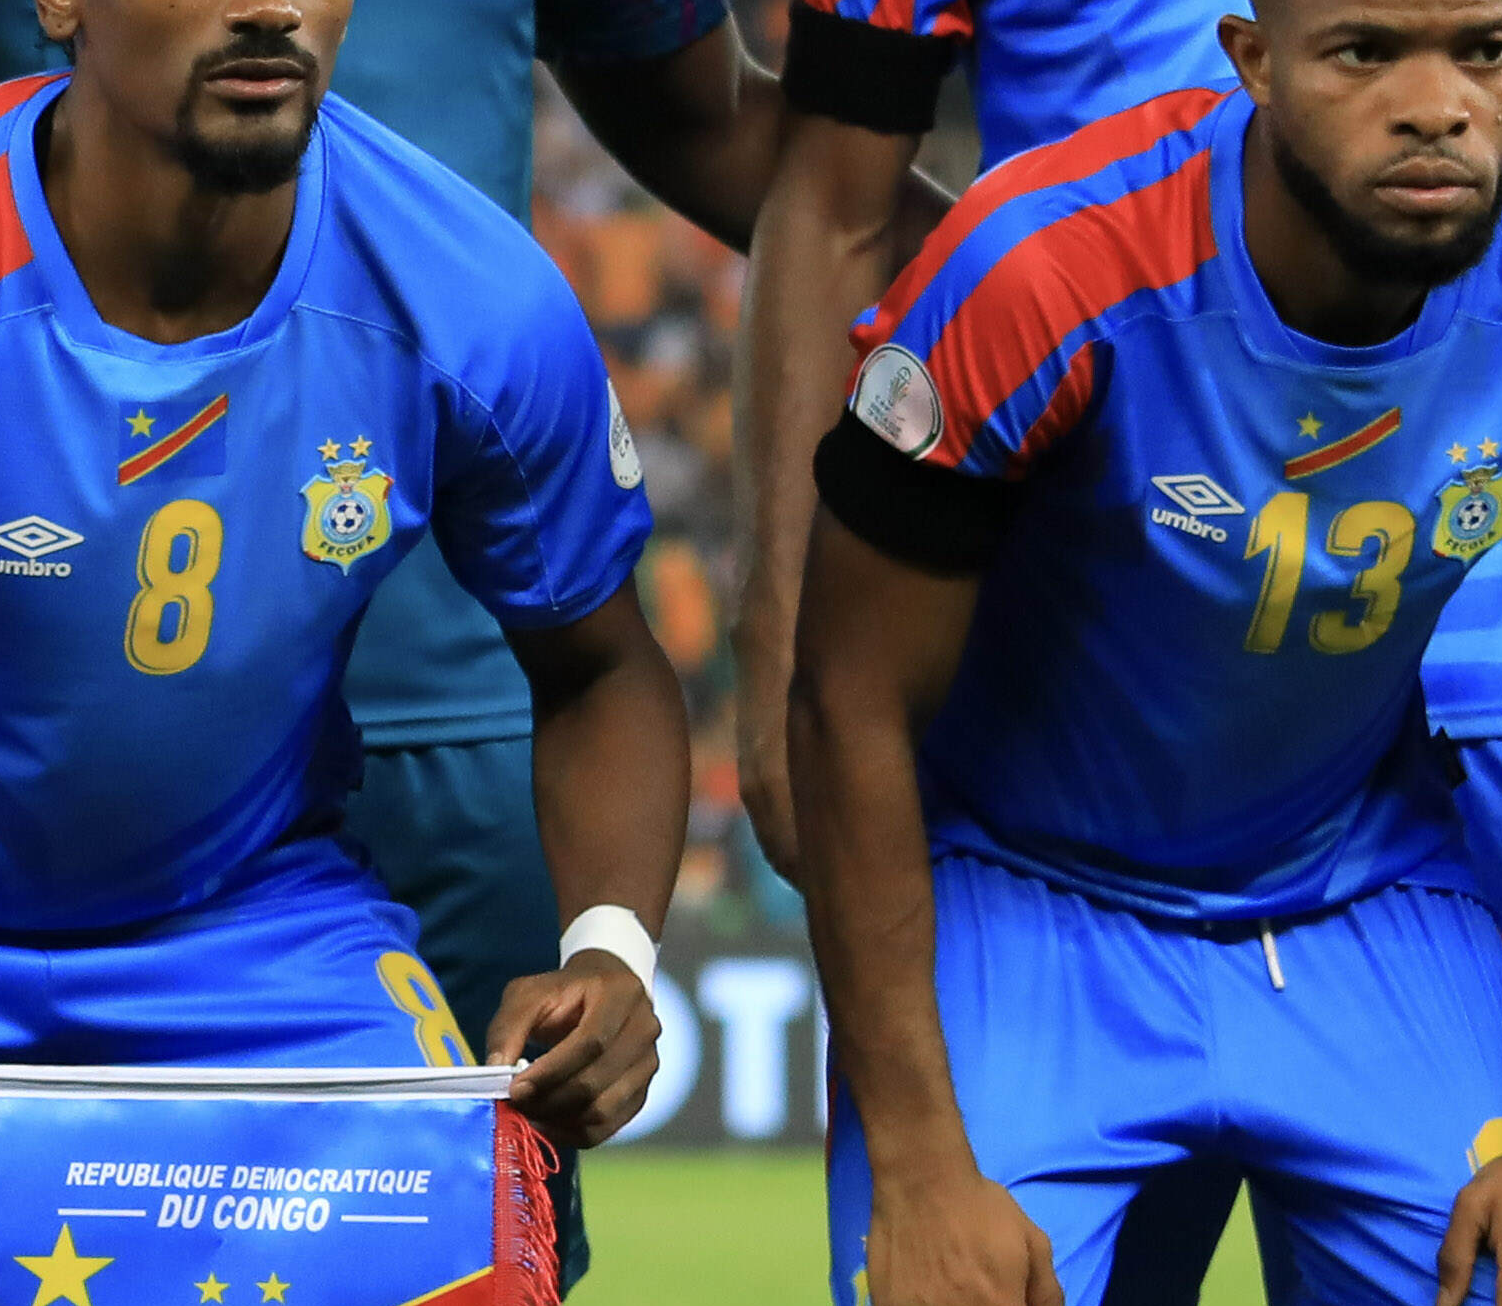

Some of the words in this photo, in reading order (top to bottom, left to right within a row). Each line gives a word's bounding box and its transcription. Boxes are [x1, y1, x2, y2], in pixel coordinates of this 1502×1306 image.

[1151, 506, 1229, 544] umbro
[318, 535, 377, 557] FECOFA
[123, 497, 224, 675] 8
[1243, 489, 1417, 655] 13
[66, 1161, 226, 1193] REPUBLIQUE
[231, 1164, 431, 1195] DEMOCRATIQUE
[156, 1194, 205, 1229] DU
[212, 1197, 331, 1234] CONGO
